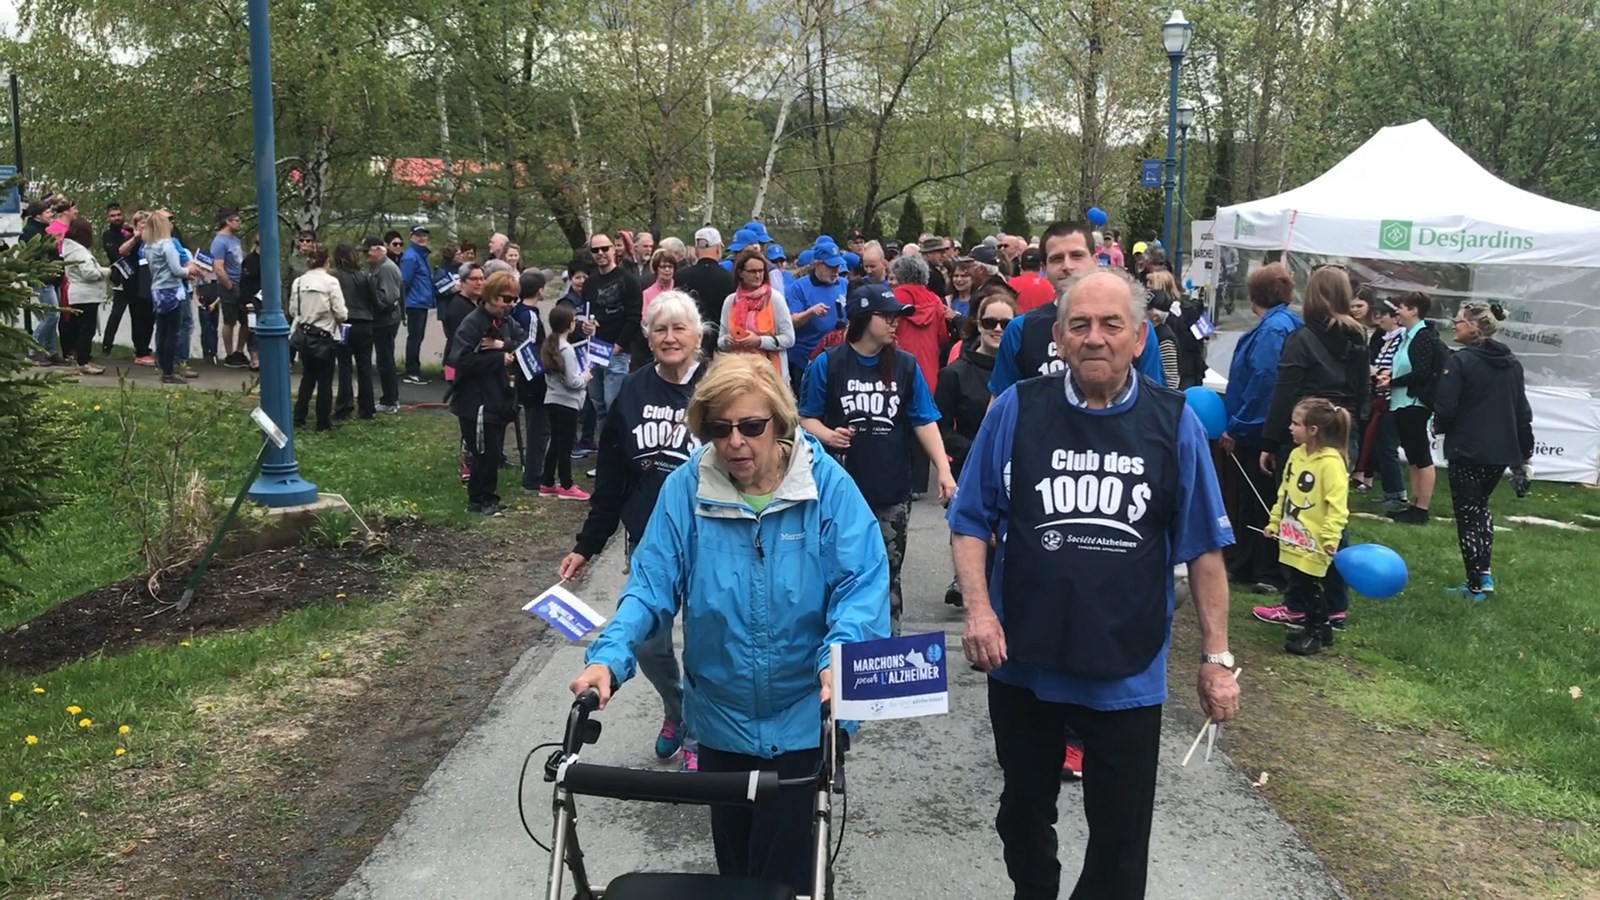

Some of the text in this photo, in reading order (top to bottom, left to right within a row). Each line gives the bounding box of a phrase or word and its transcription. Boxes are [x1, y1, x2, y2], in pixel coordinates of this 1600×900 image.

[1418, 227, 1534, 253] Desjardins
[847, 379, 898, 392] Club ds
[642, 404, 674, 421] Club
[840, 392, 901, 419] 500 $
[632, 420, 687, 450] 1000
[1051, 448, 1145, 475] Club des
[1034, 474, 1152, 524] 1000 $
[853, 654, 905, 672] MARCHONS
[880, 666, 940, 686] L'ALZHEIMER
